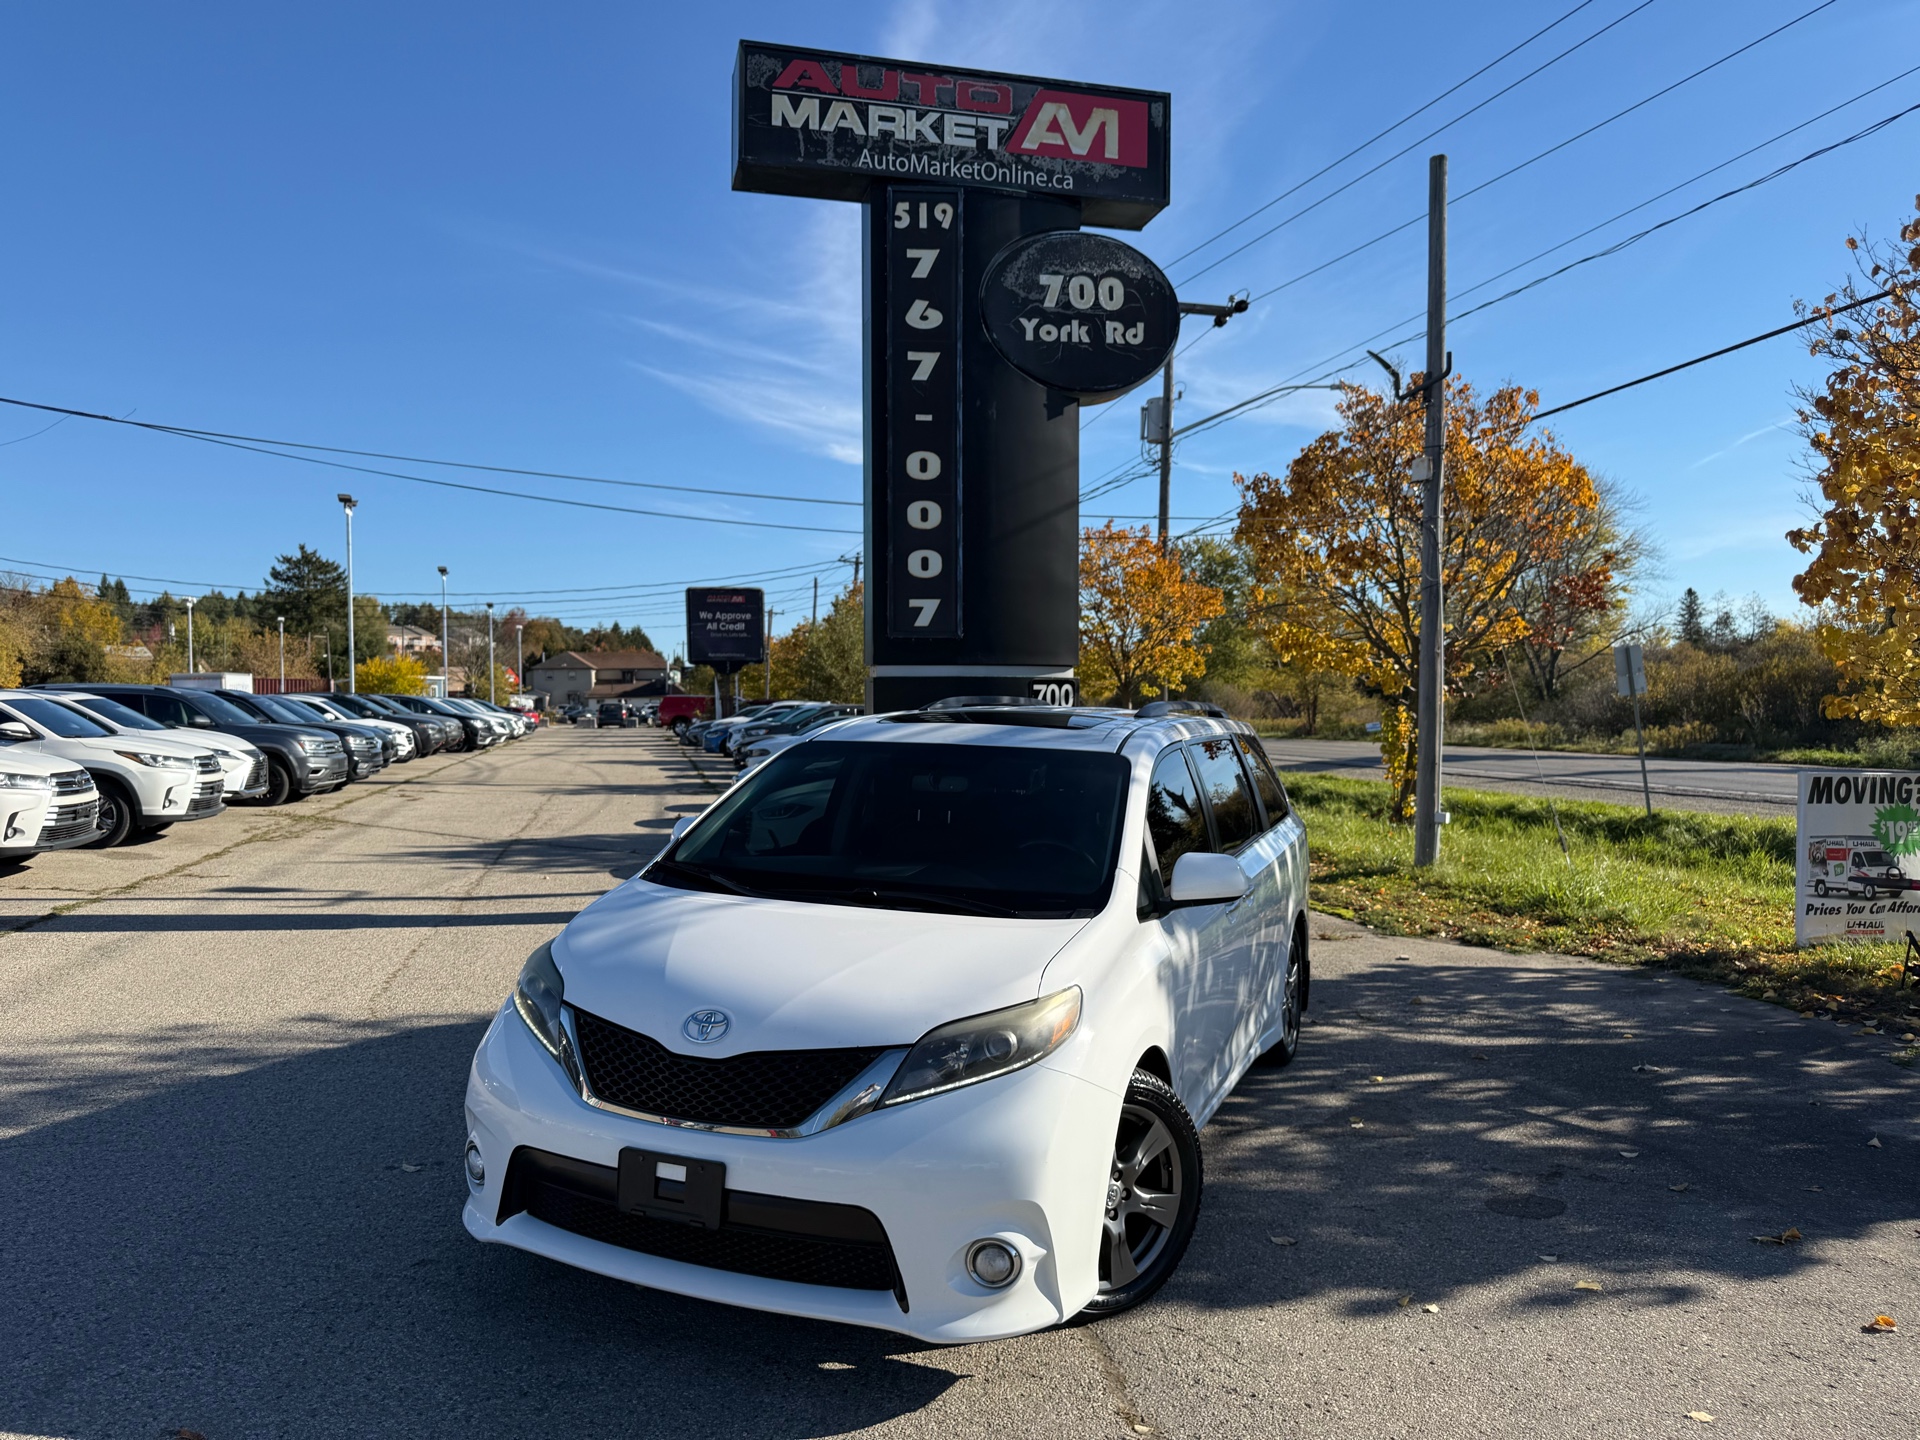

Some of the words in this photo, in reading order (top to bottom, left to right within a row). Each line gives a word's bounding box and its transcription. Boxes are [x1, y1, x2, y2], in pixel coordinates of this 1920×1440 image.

[772, 59, 1012, 114] AUTO
[771, 93, 1009, 150] MARKET
[858, 149, 1074, 190] AutoMarketOnline.ca
[894, 202, 954, 230] 519
[1039, 274, 1125, 311] 700
[1018, 317, 1091, 344] York
[1105, 320, 1145, 345] Rd
[699, 611, 713, 620] We
[715, 611, 751, 621] Approve
[706, 622, 717, 630] All
[719, 622, 745, 630] Credit
[1033, 684, 1074, 707] 700
[1805, 903, 1842, 916] Prices
[1846, 903, 1866, 915] You
[1869, 903, 1886, 915] Can
[1887, 901, 1920, 914] Affor
